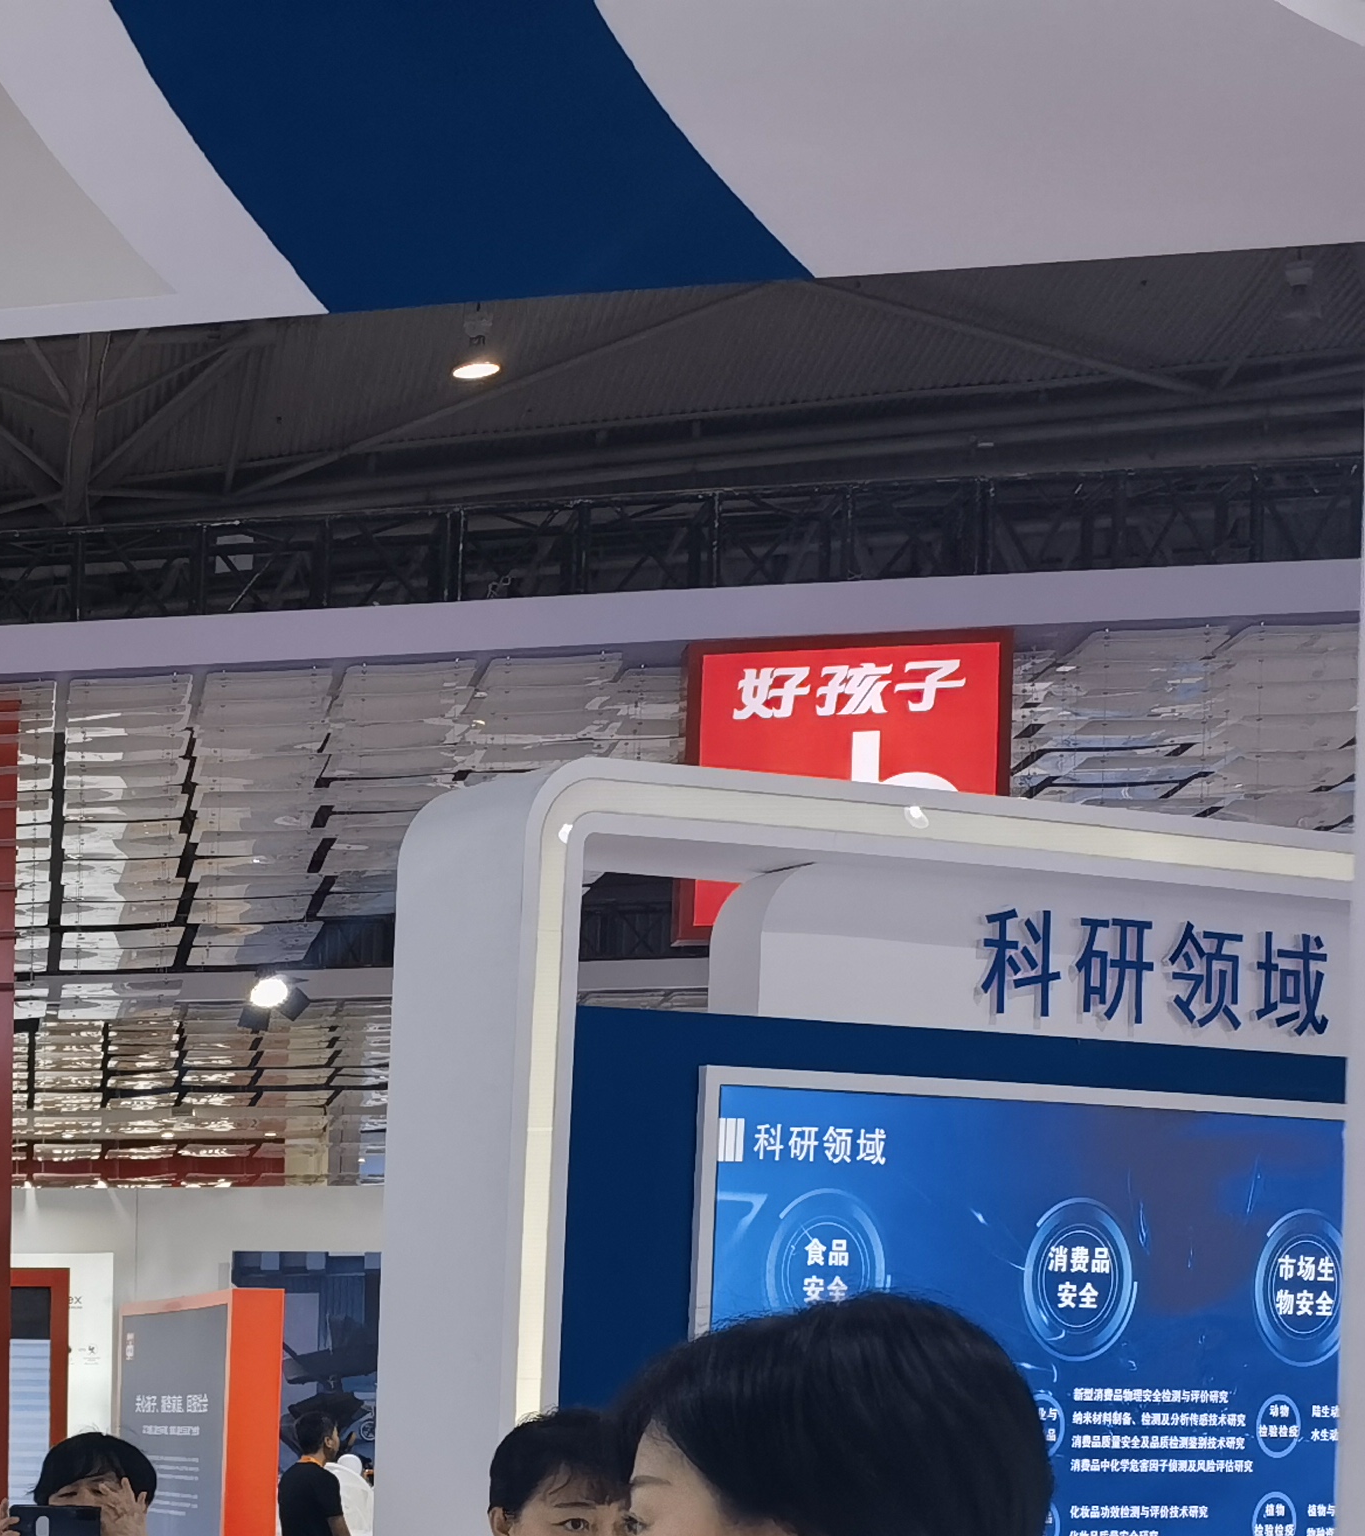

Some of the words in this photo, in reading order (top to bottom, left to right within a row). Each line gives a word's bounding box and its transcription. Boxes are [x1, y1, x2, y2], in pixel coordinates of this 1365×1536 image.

[732, 659, 966, 720] 好孩子
[980, 907, 1330, 1037] 科研领域
[753, 1123, 888, 1166] 科研领域
[804, 1238, 849, 1267] 食品
[1047, 1244, 1111, 1274] 消费品
[1278, 1254, 1335, 1284] 市场生
[802, 1275, 849, 1304] 安全
[1057, 1281, 1099, 1309] 安全
[1276, 1288, 1335, 1318] 物安全
[1073, 1387, 1229, 1404] 新型消费品物理安全检测与评价研究
[1269, 1404, 1289, 1419] 动物
[1071, 1434, 1246, 1451] 消费品质量安全及品质检测鉴别技术研究
[1258, 1424, 1299, 1439] 检验检疫
[1070, 1504, 1209, 1520] 化妆品功效检测与评价技术研究
[1265, 1504, 1285, 1518] 植物
